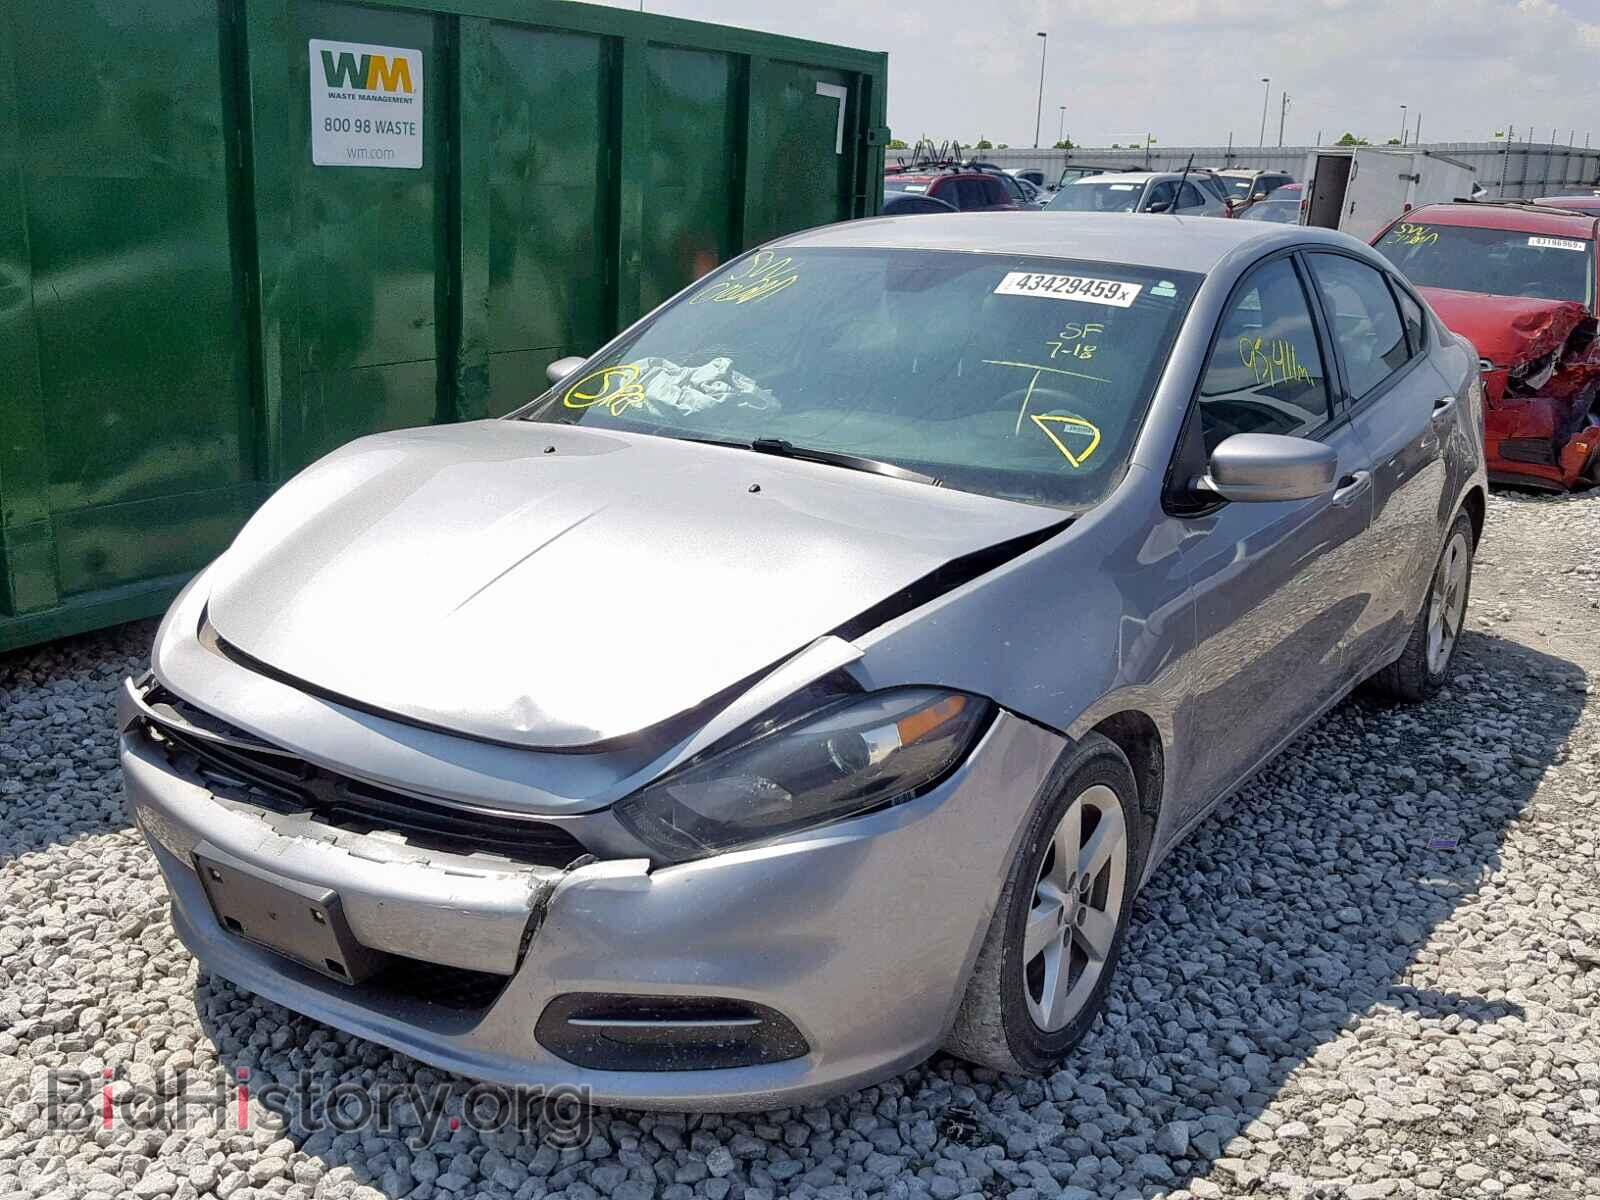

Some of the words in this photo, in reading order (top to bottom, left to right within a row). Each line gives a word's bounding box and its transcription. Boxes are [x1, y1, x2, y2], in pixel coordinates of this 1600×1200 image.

[320, 50, 413, 93] WM
[328, 92, 356, 100] WASTE
[358, 94, 413, 104] MANAGEMENT
[324, 117, 351, 132] 800
[354, 119, 372, 133] 98
[375, 120, 416, 136] WASTE
[346, 147, 394, 160] wm.com
